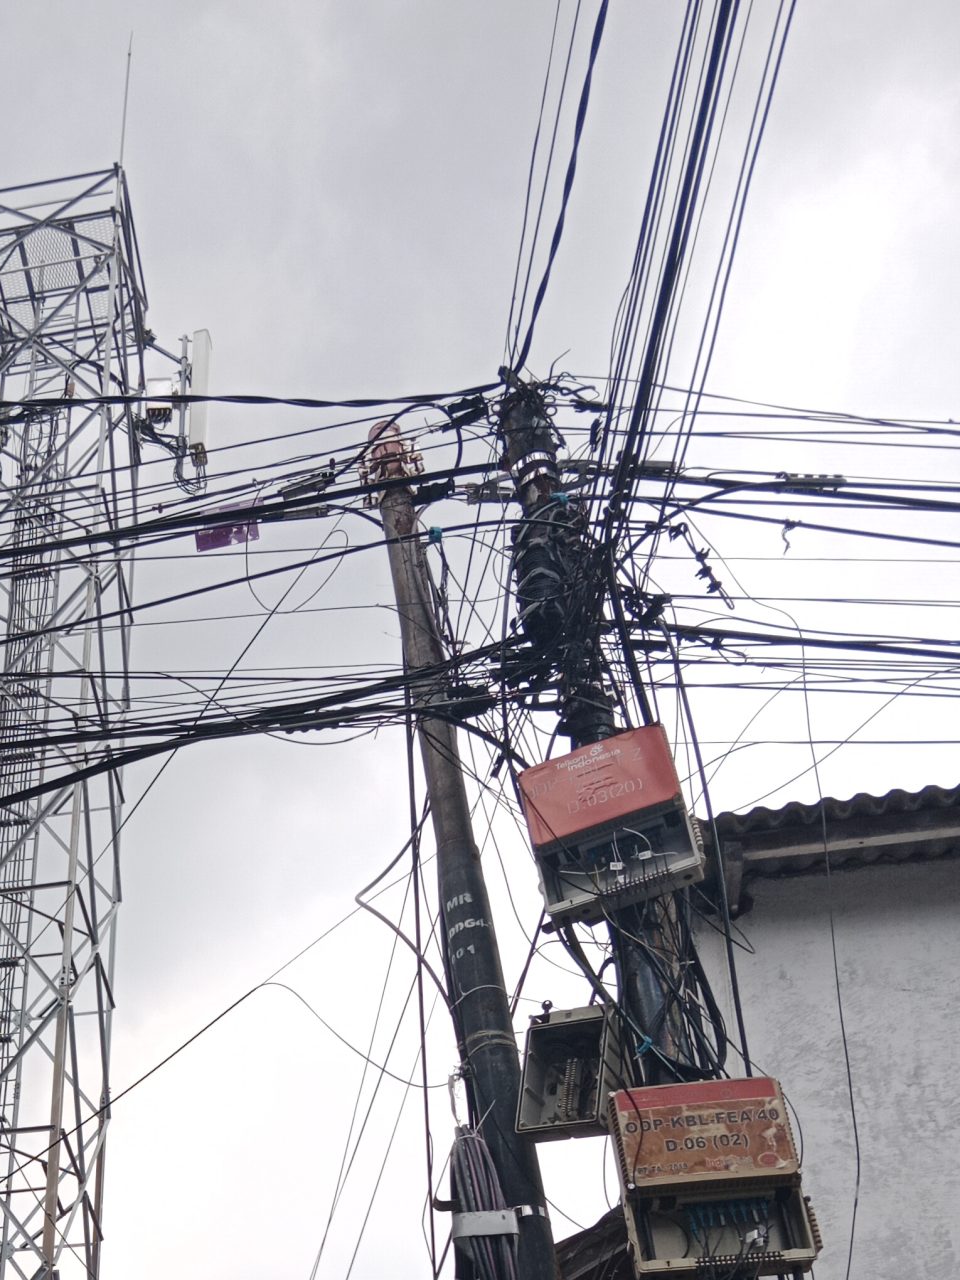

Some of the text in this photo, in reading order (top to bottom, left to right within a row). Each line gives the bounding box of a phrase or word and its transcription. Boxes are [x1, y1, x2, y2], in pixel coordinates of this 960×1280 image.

[556, 754, 587, 770] Telkom
[567, 749, 621, 771] Indonesia
[446, 893, 473, 912] MR
[713, 1133, 749, 1151] (02)
